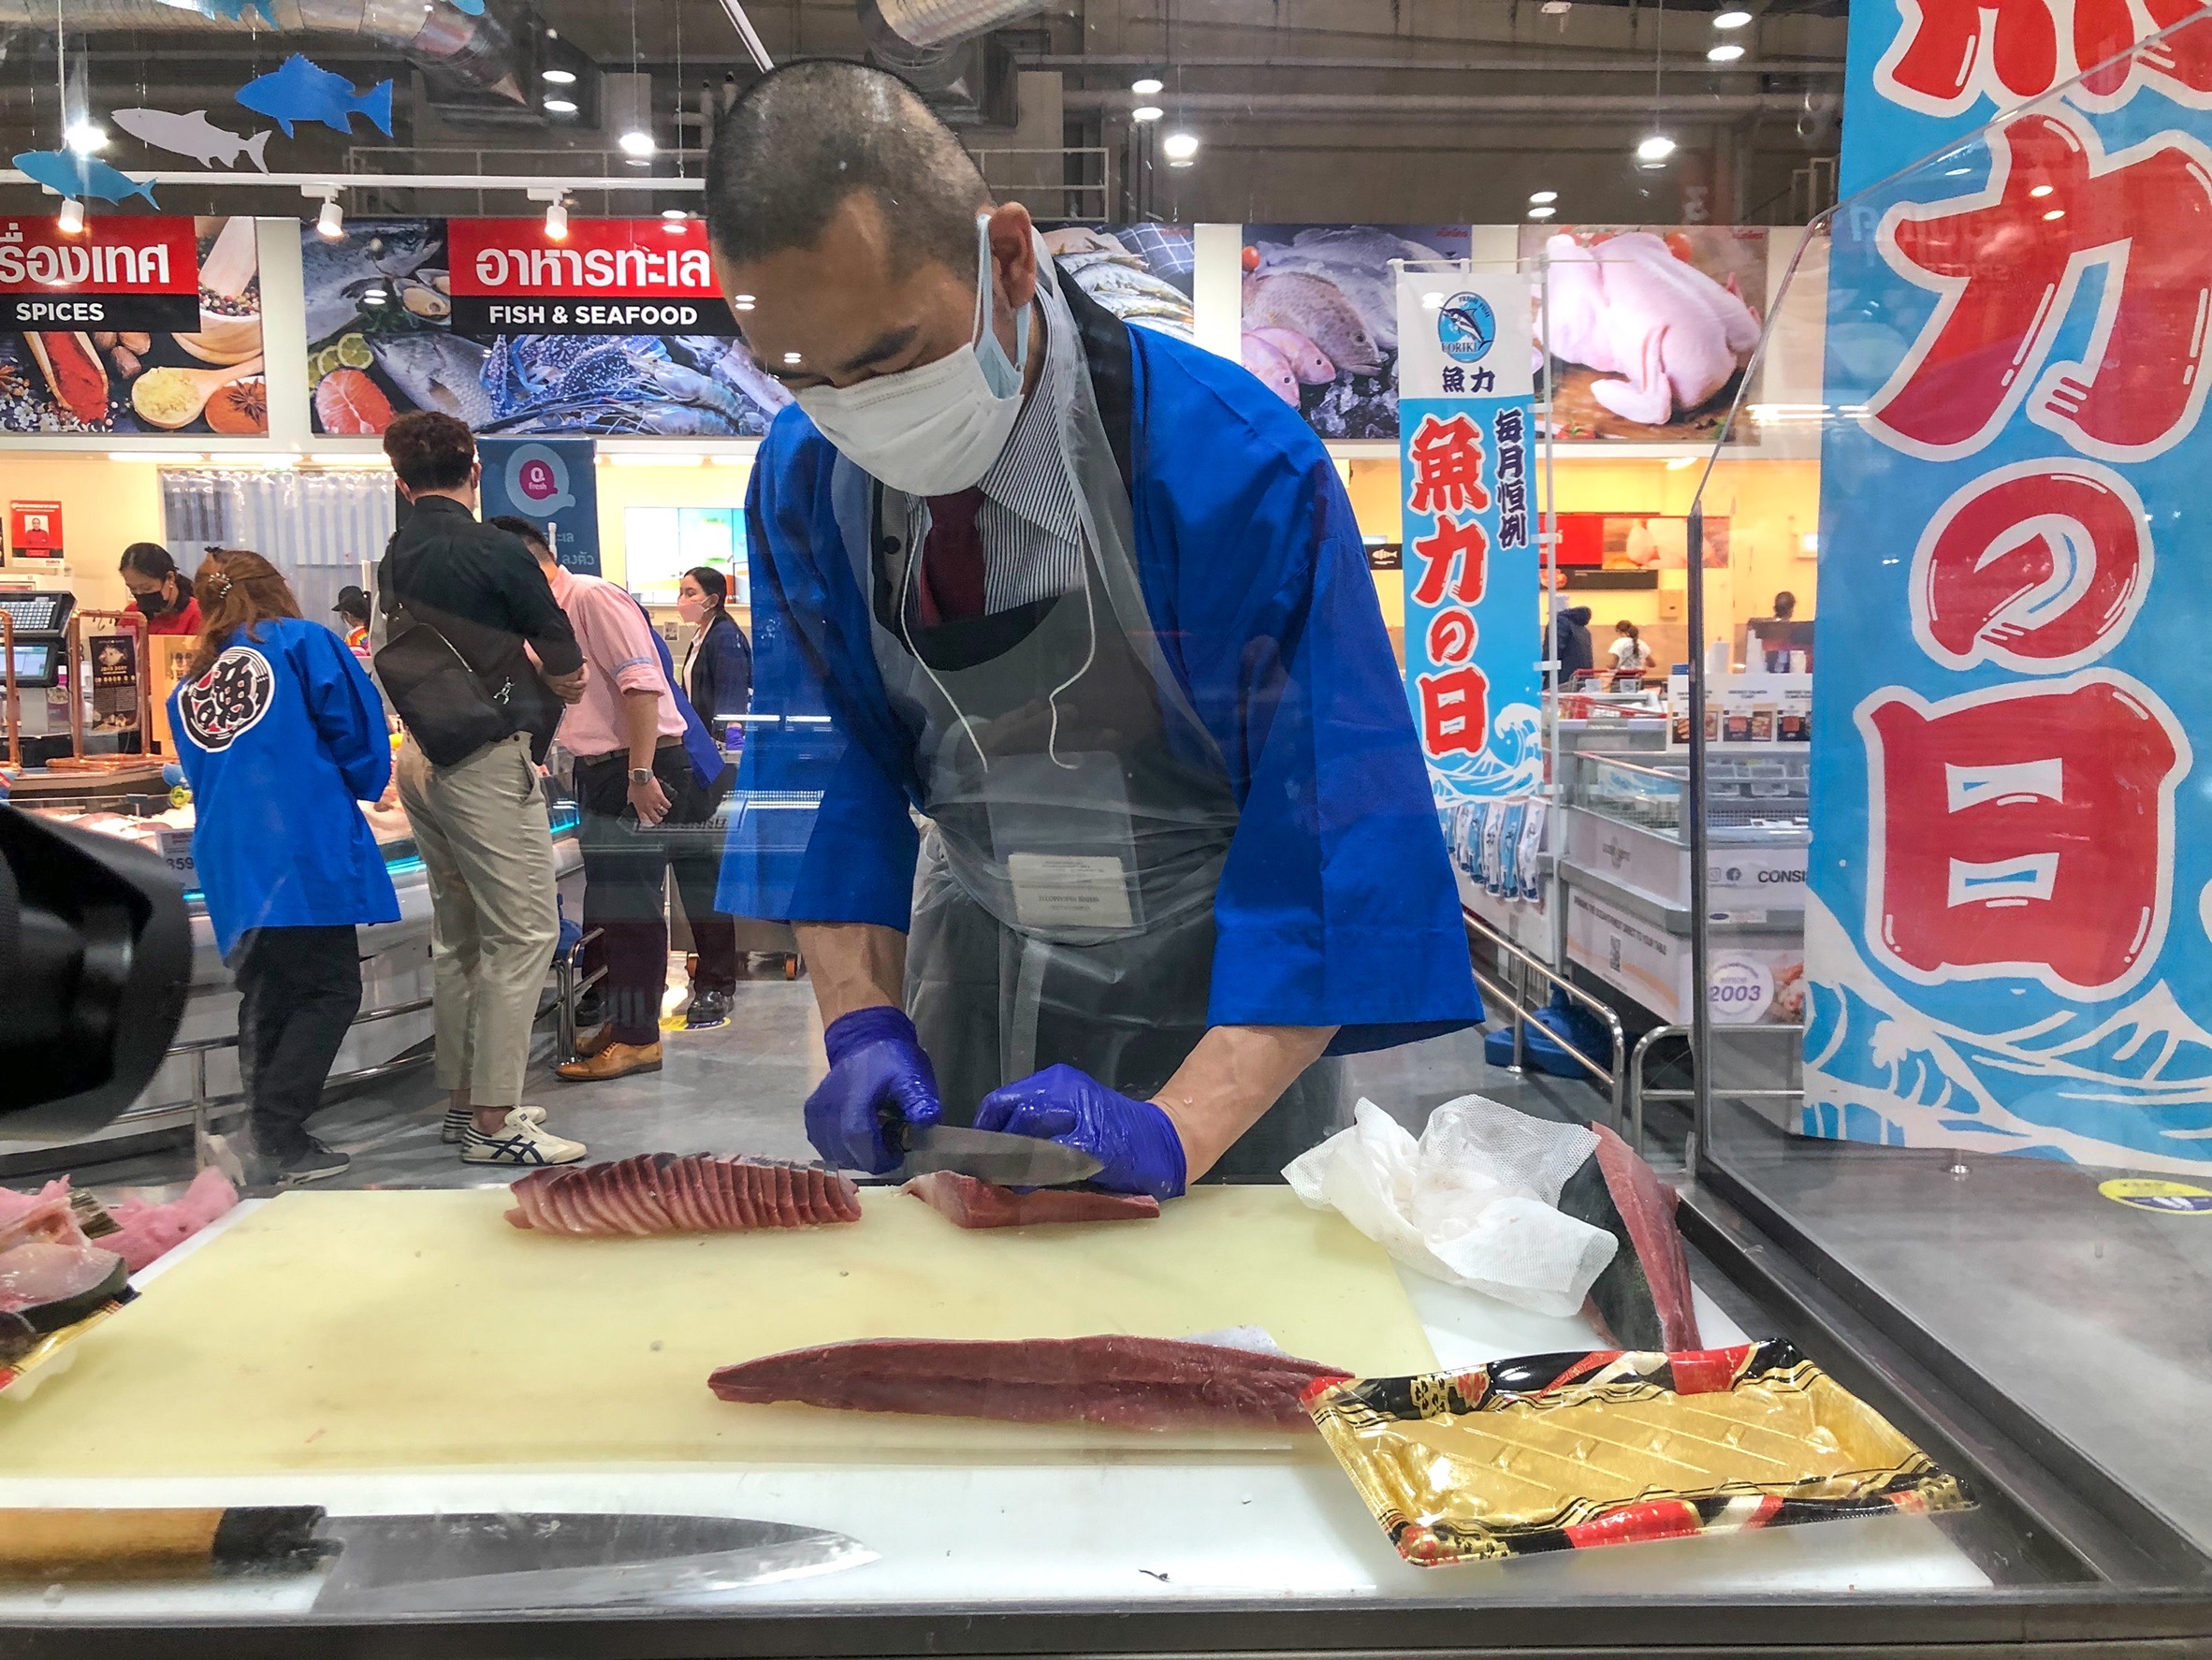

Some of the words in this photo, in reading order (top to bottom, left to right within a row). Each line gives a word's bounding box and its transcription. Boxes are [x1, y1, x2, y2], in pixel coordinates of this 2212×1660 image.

[475, 247, 711, 287] อาหารทะเล
[16, 302, 105, 322] SPICES
[489, 305, 545, 324] FISH
[552, 306, 569, 324] &
[575, 306, 698, 325] SEAFOOD
[1442, 366, 1495, 393] 魚力
[1495, 408, 1528, 550] 毎月恒例
[1409, 415, 1491, 757] 魚力の日
[1710, 985, 1762, 1002] 2003
